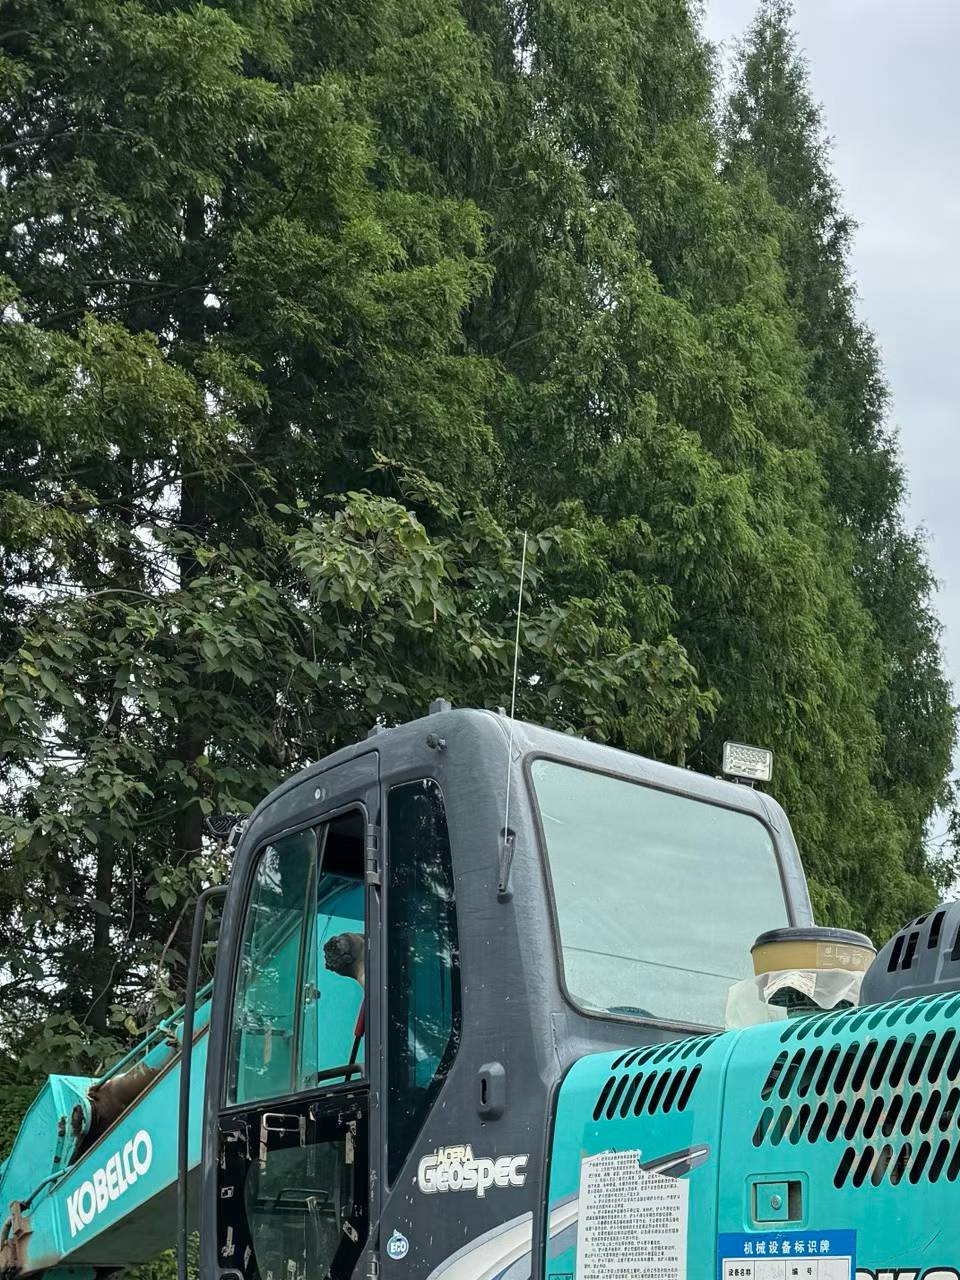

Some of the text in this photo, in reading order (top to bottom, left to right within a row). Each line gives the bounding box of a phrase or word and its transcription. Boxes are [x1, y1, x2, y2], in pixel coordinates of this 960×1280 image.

[67, 1129, 153, 1238] KOBELCO
[390, 1242, 406, 1252] ECO
[743, 1240, 830, 1255] 机械设备标识牌
[728, 1268, 751, 1276] 设备名称
